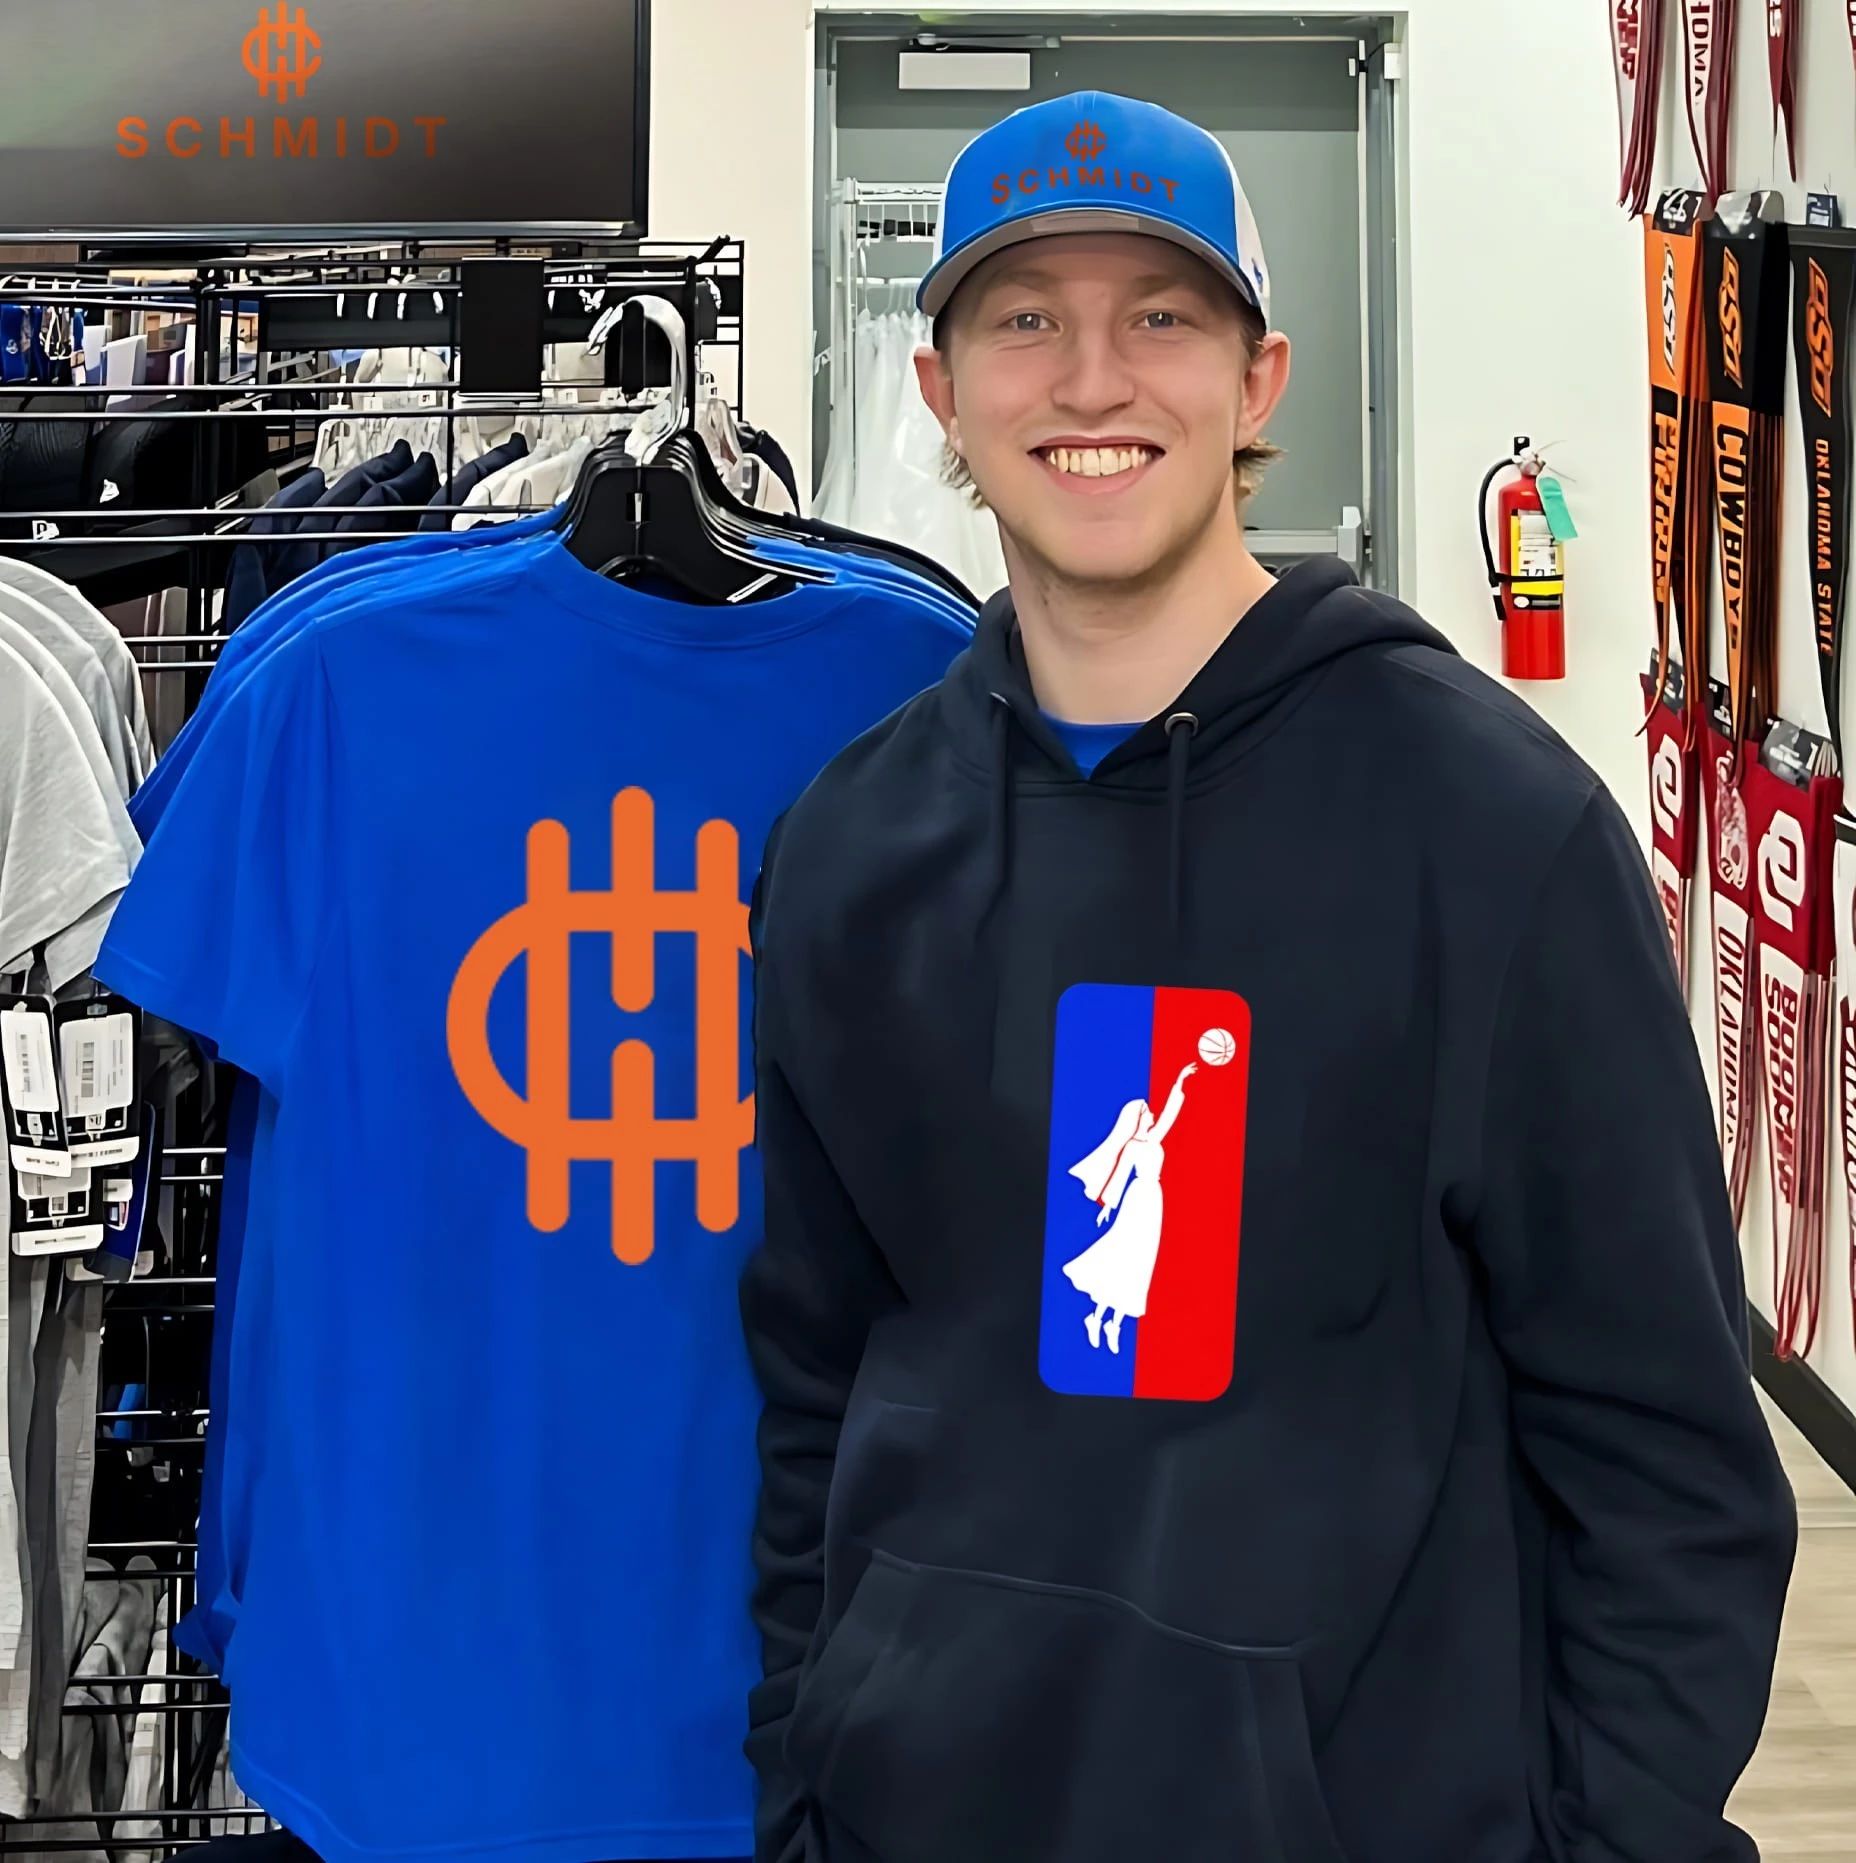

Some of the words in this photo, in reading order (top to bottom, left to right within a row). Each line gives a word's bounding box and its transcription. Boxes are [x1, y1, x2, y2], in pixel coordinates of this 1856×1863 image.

[115, 116, 449, 160] SCHMIDT
[991, 166, 1180, 205] SCHMIDT
[1815, 438, 1833, 570] OKLAHOMA
[1817, 583, 1834, 657] STATE
[1718, 926, 1746, 1144] OKLAHOMA
